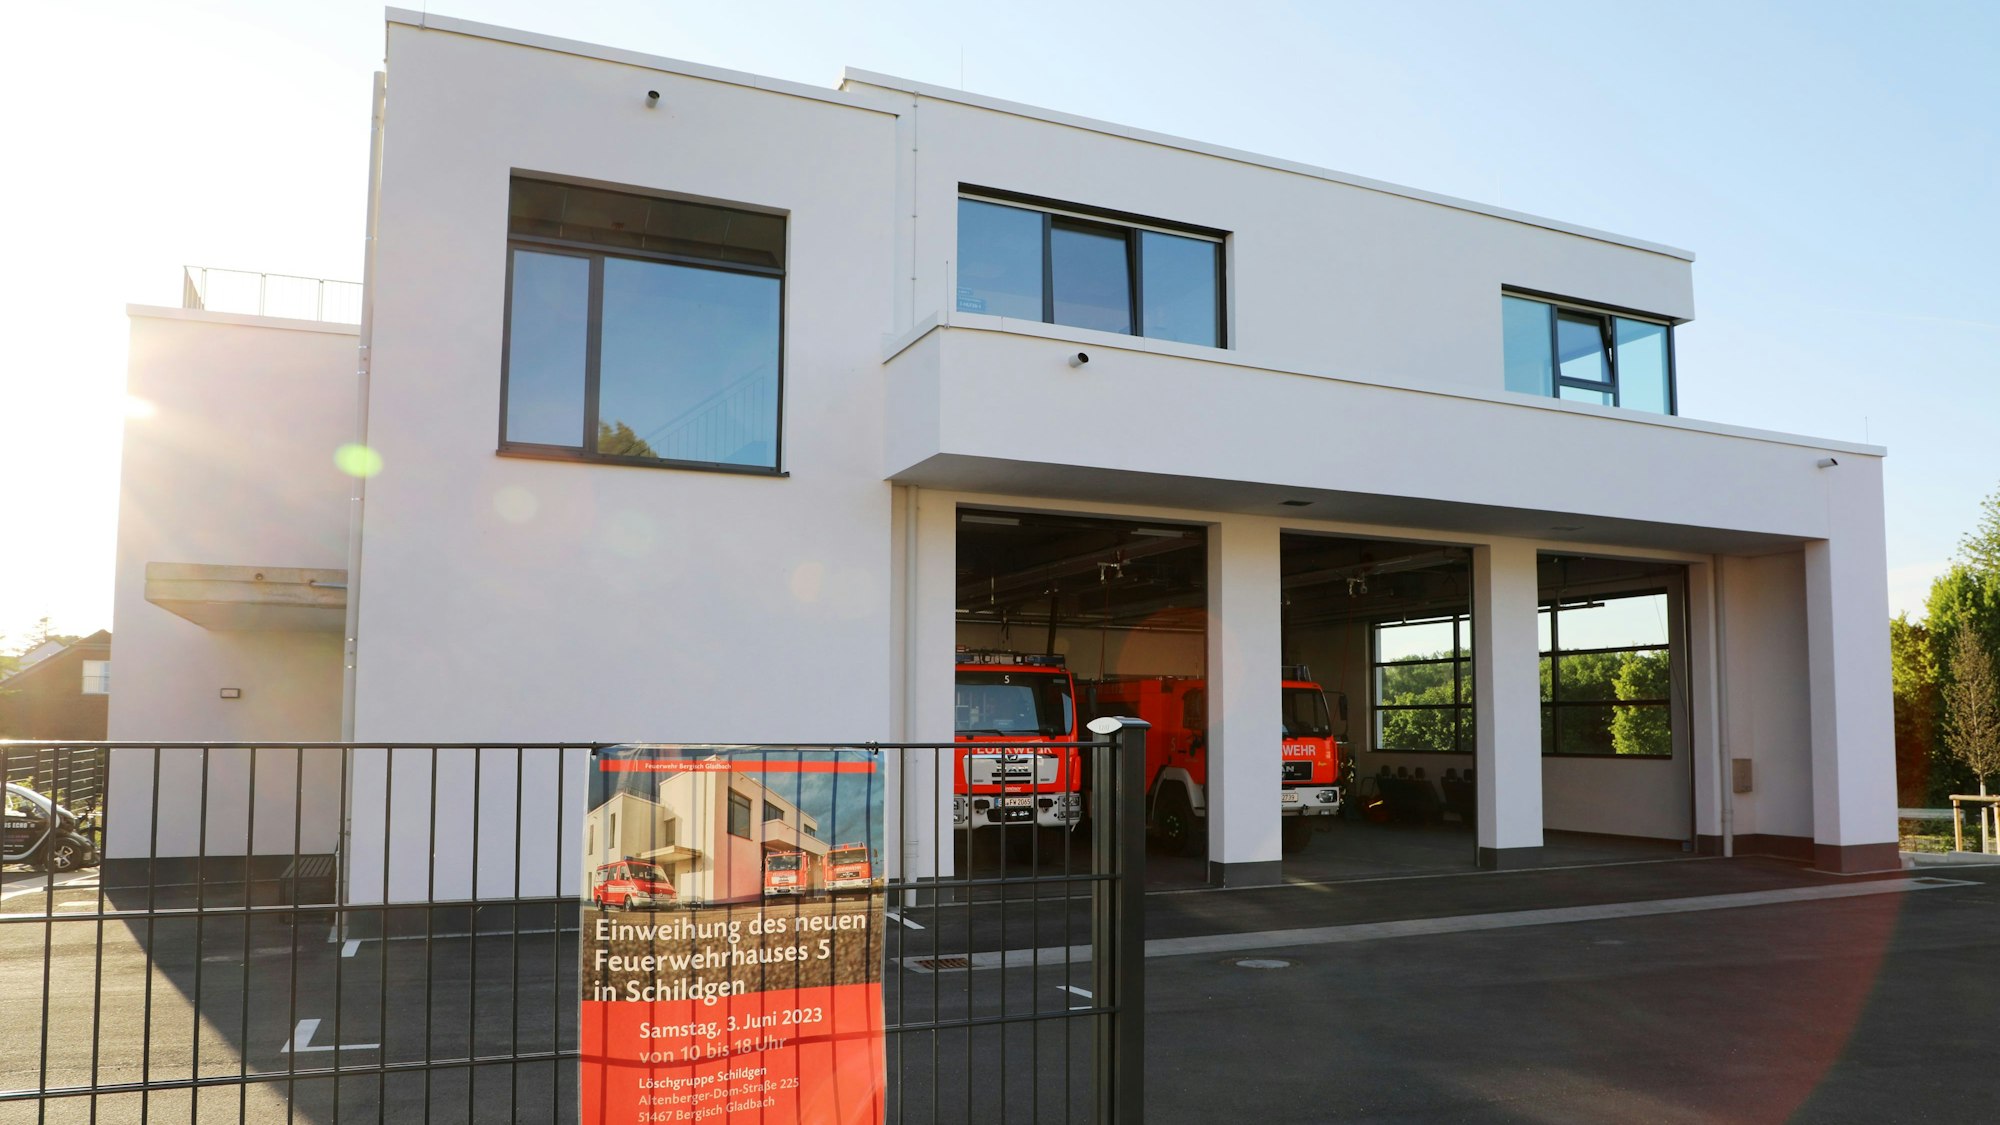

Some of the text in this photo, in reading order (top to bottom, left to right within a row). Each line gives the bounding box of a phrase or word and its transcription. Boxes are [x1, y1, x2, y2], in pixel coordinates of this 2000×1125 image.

[679, 762, 704, 771] Bergisch
[595, 912, 866, 944] Einweihung des neuen
[594, 938, 831, 972] Feuerwehrhauses 5
[594, 976, 745, 1006] in Schildgen
[639, 1007, 823, 1040] Samstag, 3. Juni 2023
[639, 1033, 788, 1064] von 10 bis 18 Uhr
[637, 1077, 800, 1106] Altenberger-Dom-Straße 225
[638, 1066, 767, 1091] Löschgruppe Schildgen
[637, 1096, 775, 1123] 51467 Bergisch Gladbach
